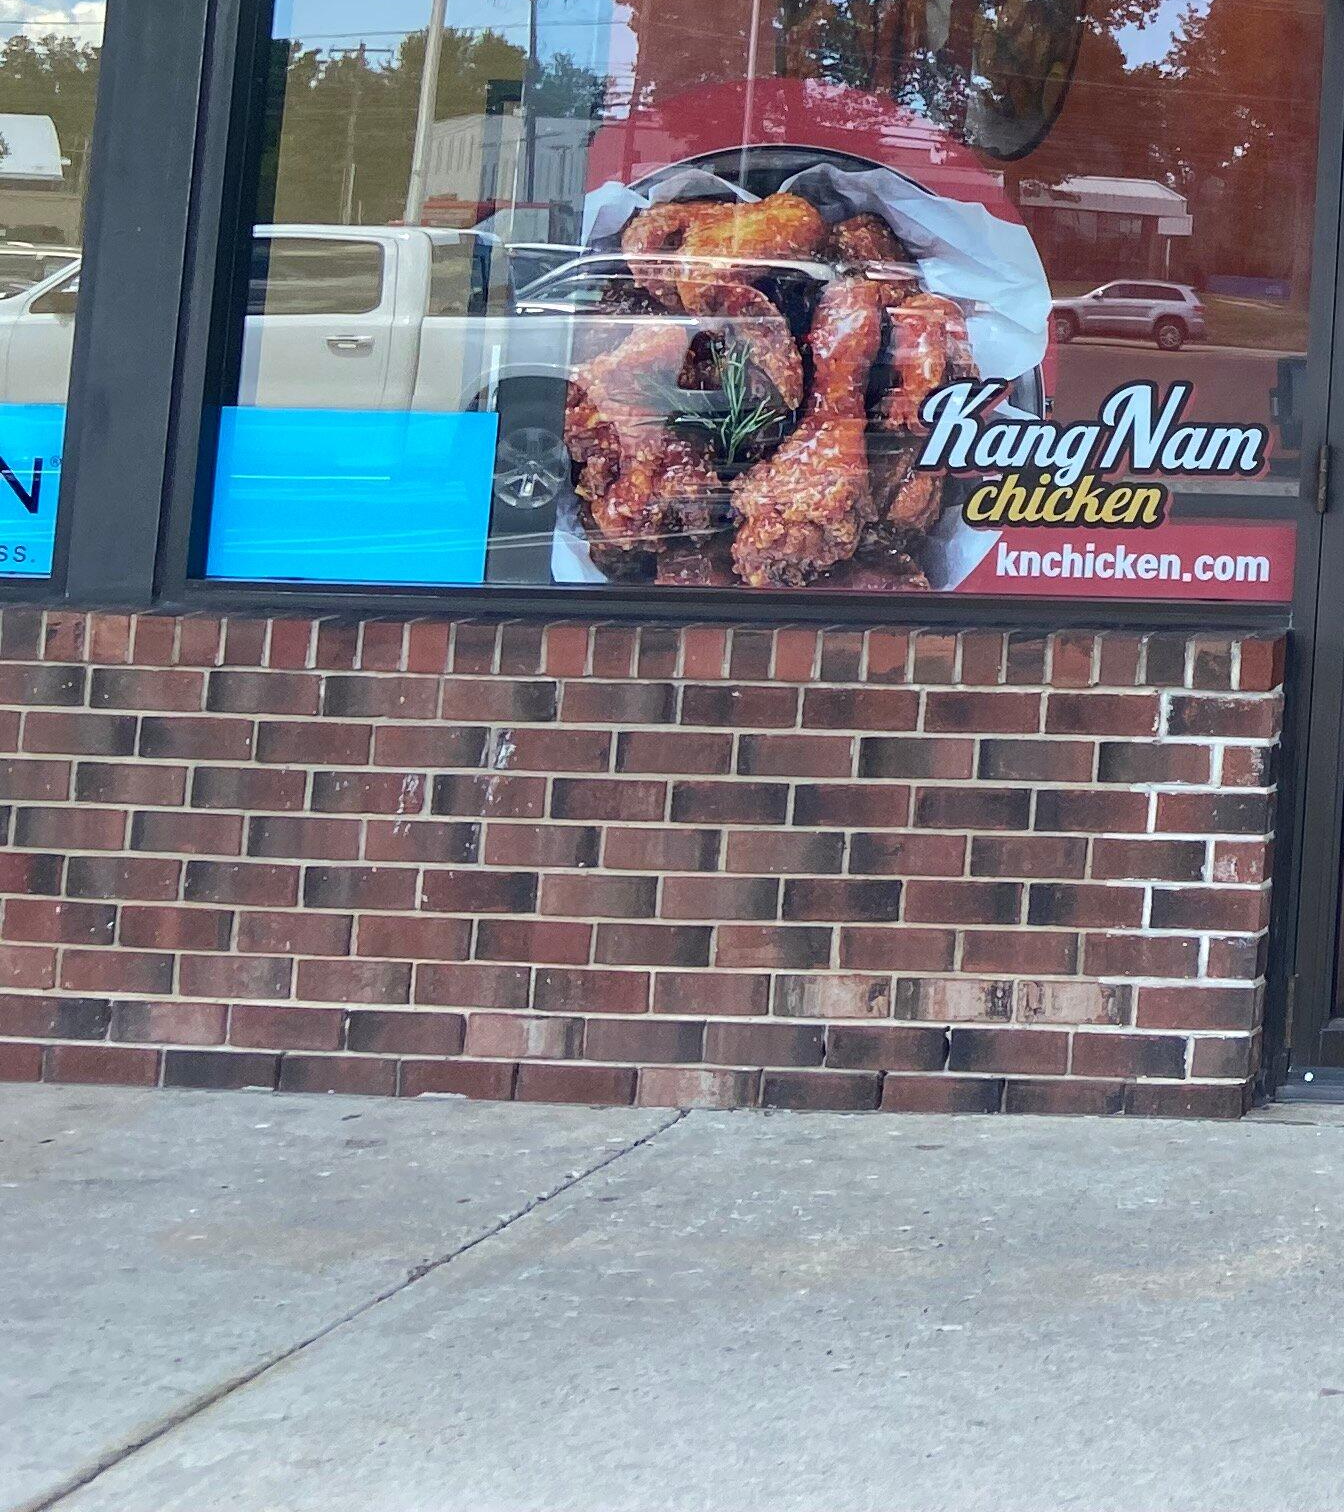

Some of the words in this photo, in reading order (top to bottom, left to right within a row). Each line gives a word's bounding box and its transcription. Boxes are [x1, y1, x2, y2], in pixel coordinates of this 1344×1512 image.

[919, 382, 1100, 487] Kang
[1101, 384, 1264, 472] Nam
[966, 473, 1162, 524] chicken
[995, 542, 1271, 583] knchicken.com
